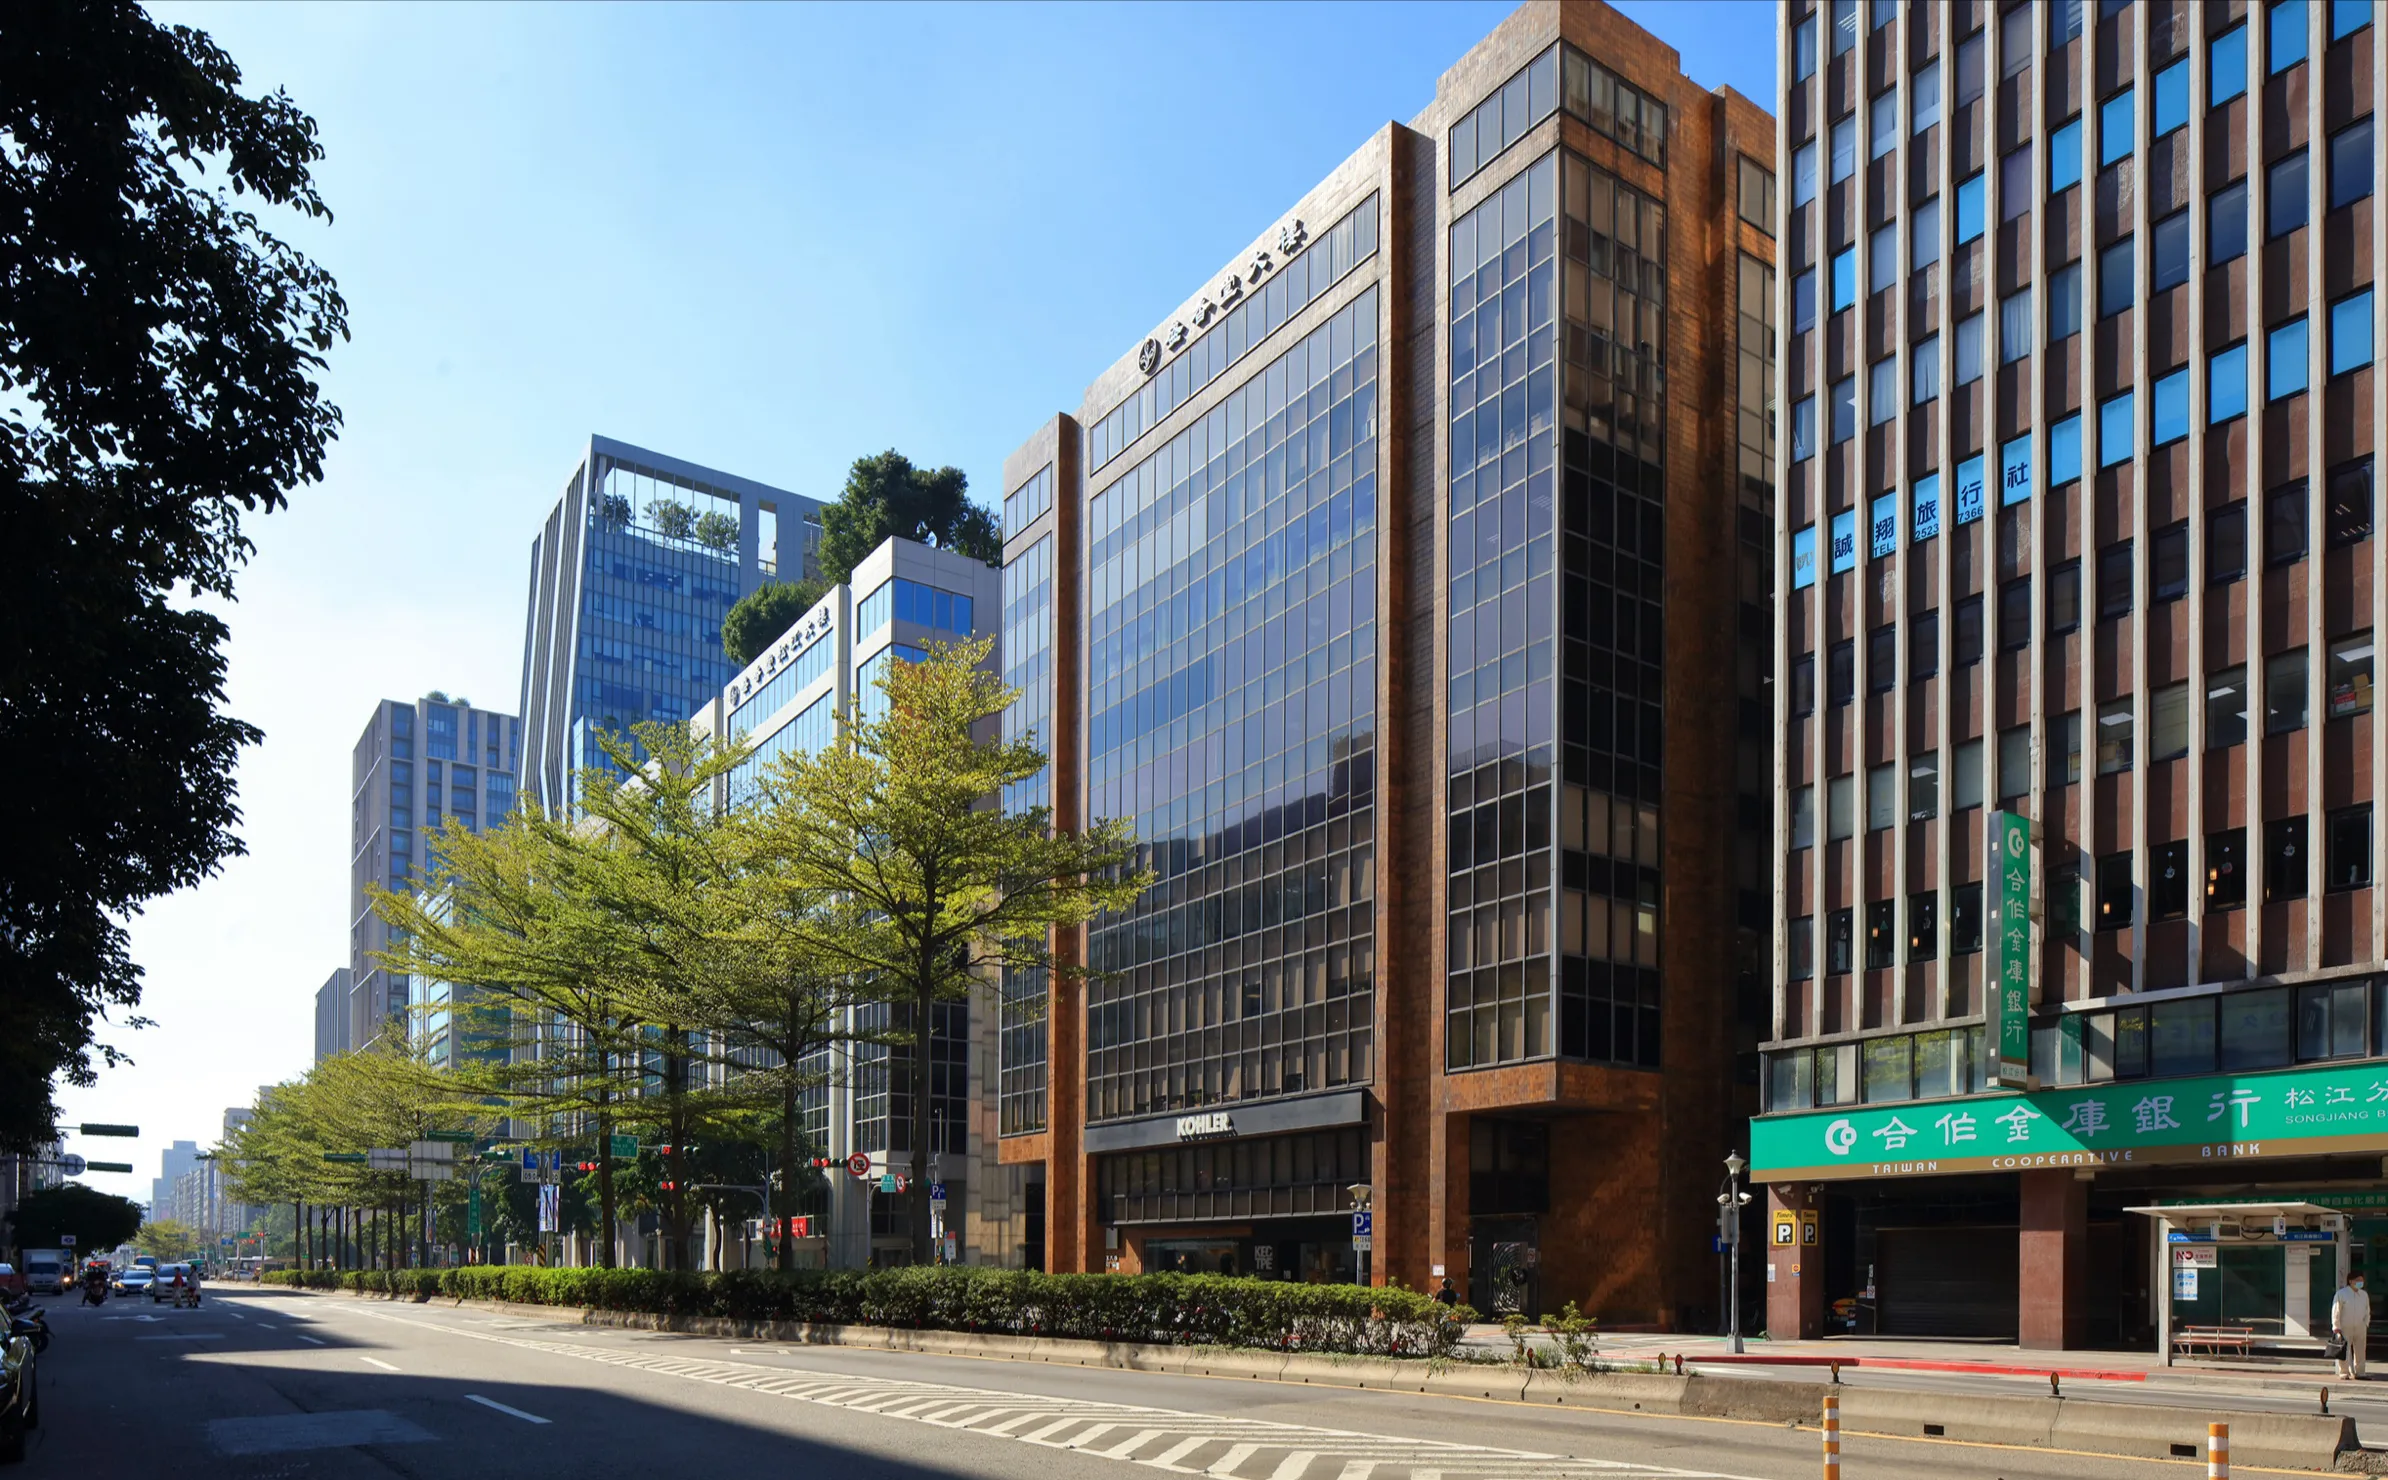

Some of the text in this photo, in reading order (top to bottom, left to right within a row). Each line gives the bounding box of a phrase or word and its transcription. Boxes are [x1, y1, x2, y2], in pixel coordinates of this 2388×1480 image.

[1834, 462, 2029, 560] 誠翔旅行社
[1915, 523, 1939, 540] 2523
[1958, 505, 1984, 523] 7366
[2006, 867, 2025, 1044] 合作金庫銀行
[1872, 1088, 2262, 1151] 合作金庫銀行
[2285, 1110, 2369, 1124] SONGJIANG
[1872, 1143, 2260, 1174] TAIWAN COOPERATIVE BANK
[1777, 1224, 1791, 1242] P
